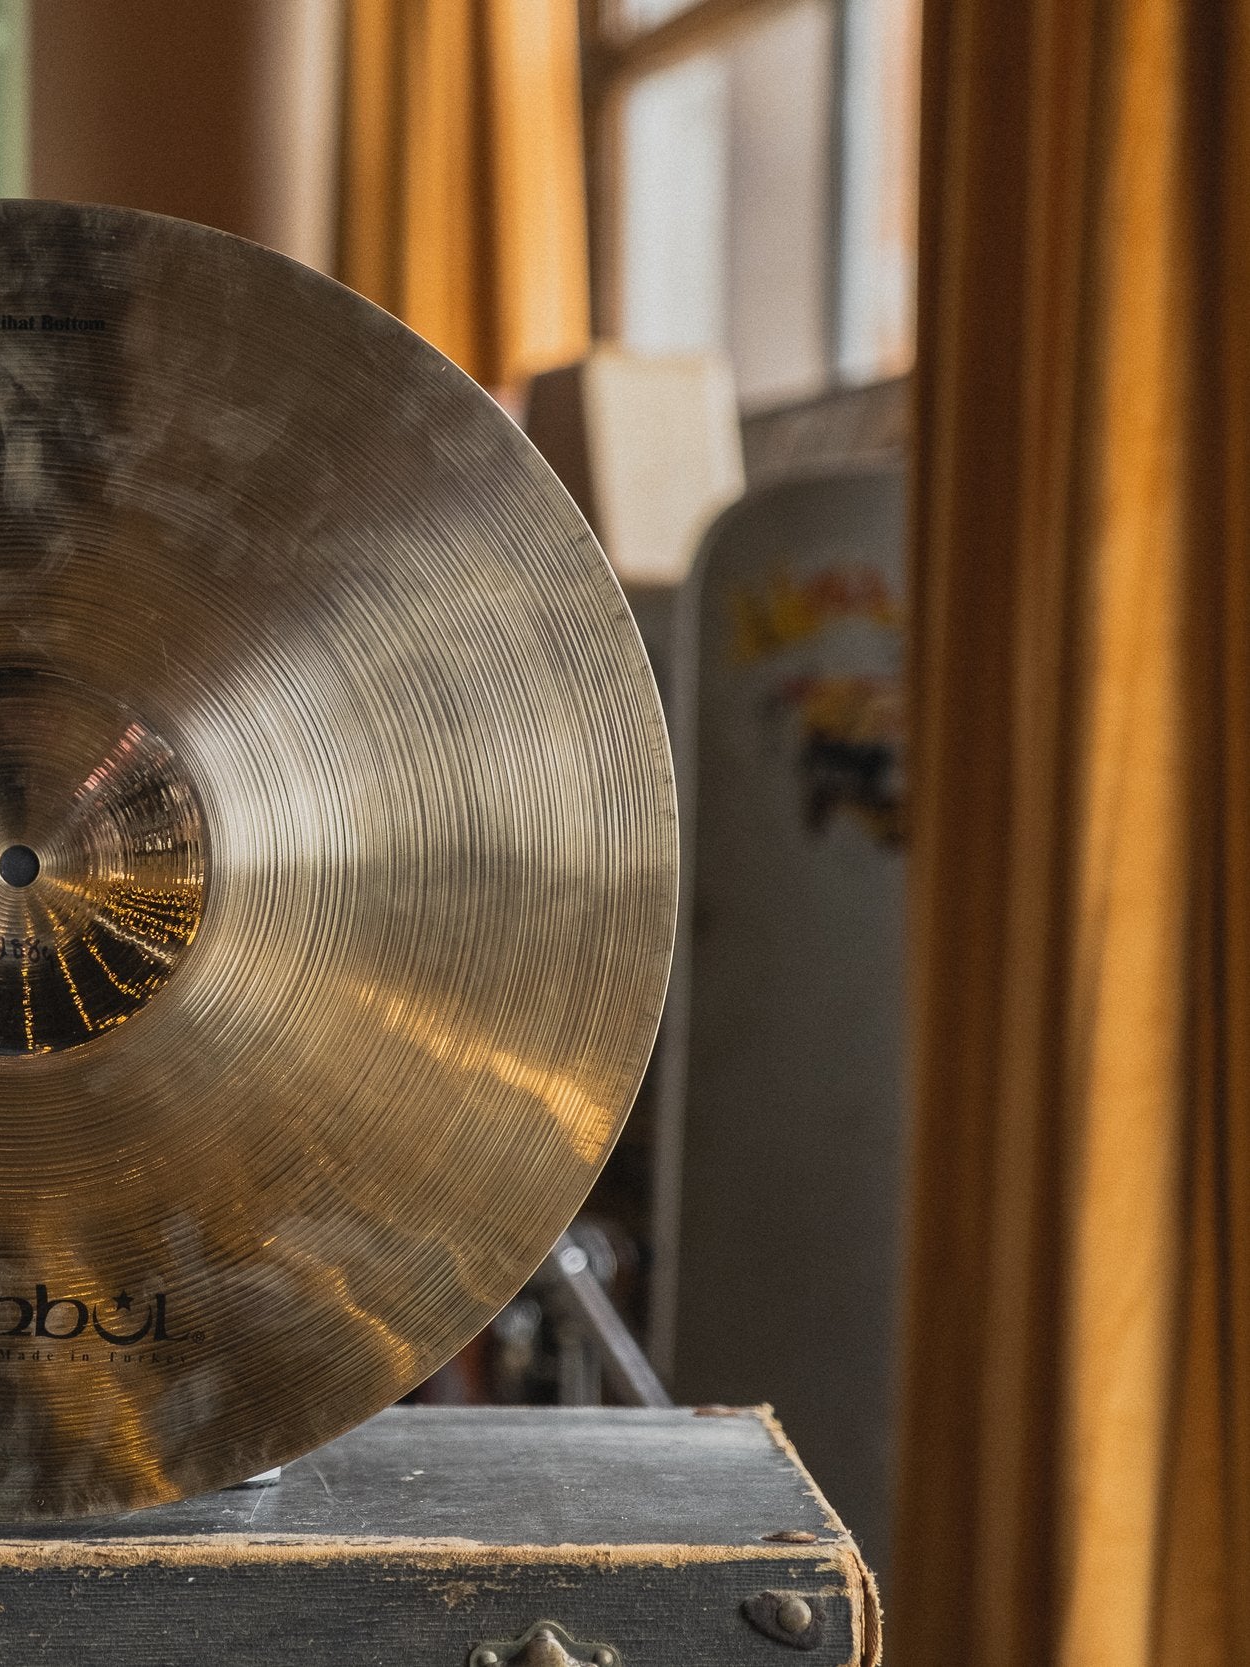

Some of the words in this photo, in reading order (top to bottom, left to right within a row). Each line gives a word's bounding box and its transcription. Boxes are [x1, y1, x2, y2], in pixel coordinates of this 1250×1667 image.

[41, 314, 106, 331] Bottom
[70, 1349, 90, 1362] in
[110, 1350, 188, 1364] Turkey
